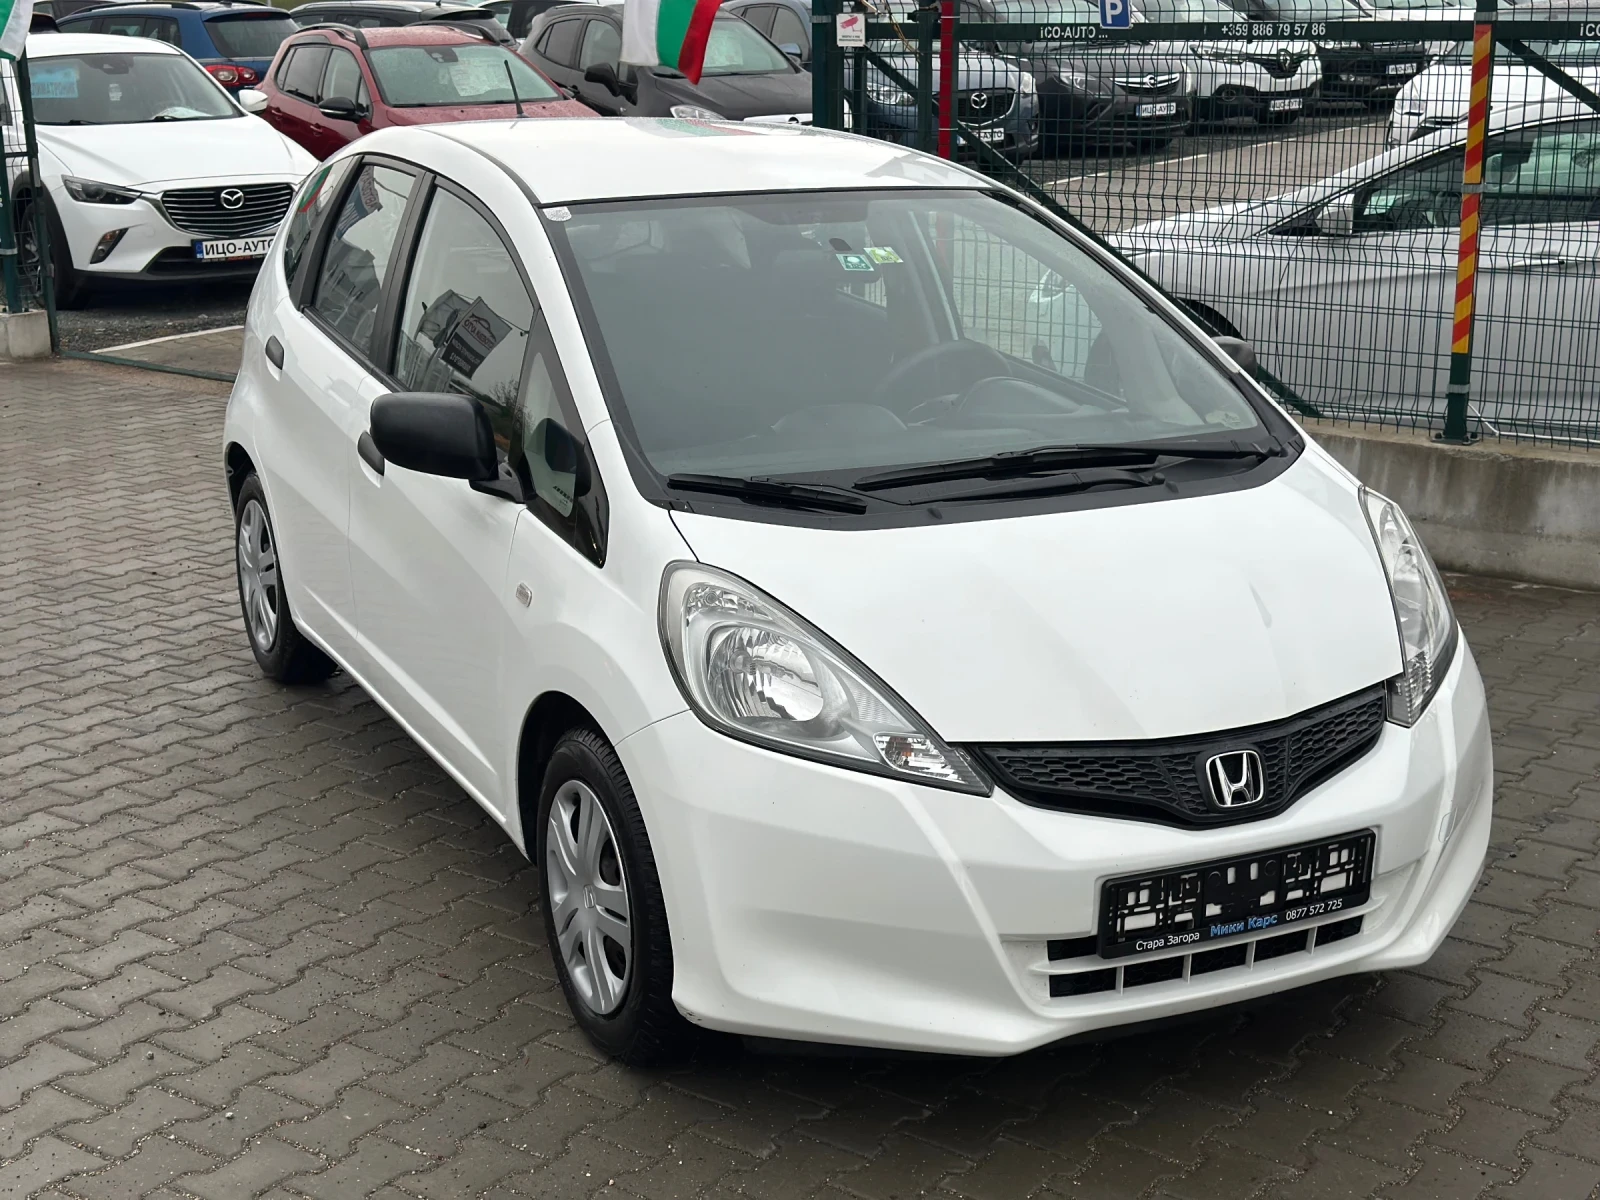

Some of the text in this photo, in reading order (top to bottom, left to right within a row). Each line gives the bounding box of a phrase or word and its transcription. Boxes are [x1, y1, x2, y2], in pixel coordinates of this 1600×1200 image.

[1105, 0, 1123, 24] P
[1276, 23, 1291, 36] 79
[1294, 23, 1308, 36] 57
[1311, 23, 1326, 35] 86
[1136, 898, 1343, 951] Стара Загора Мики Карс 0877 572 725
